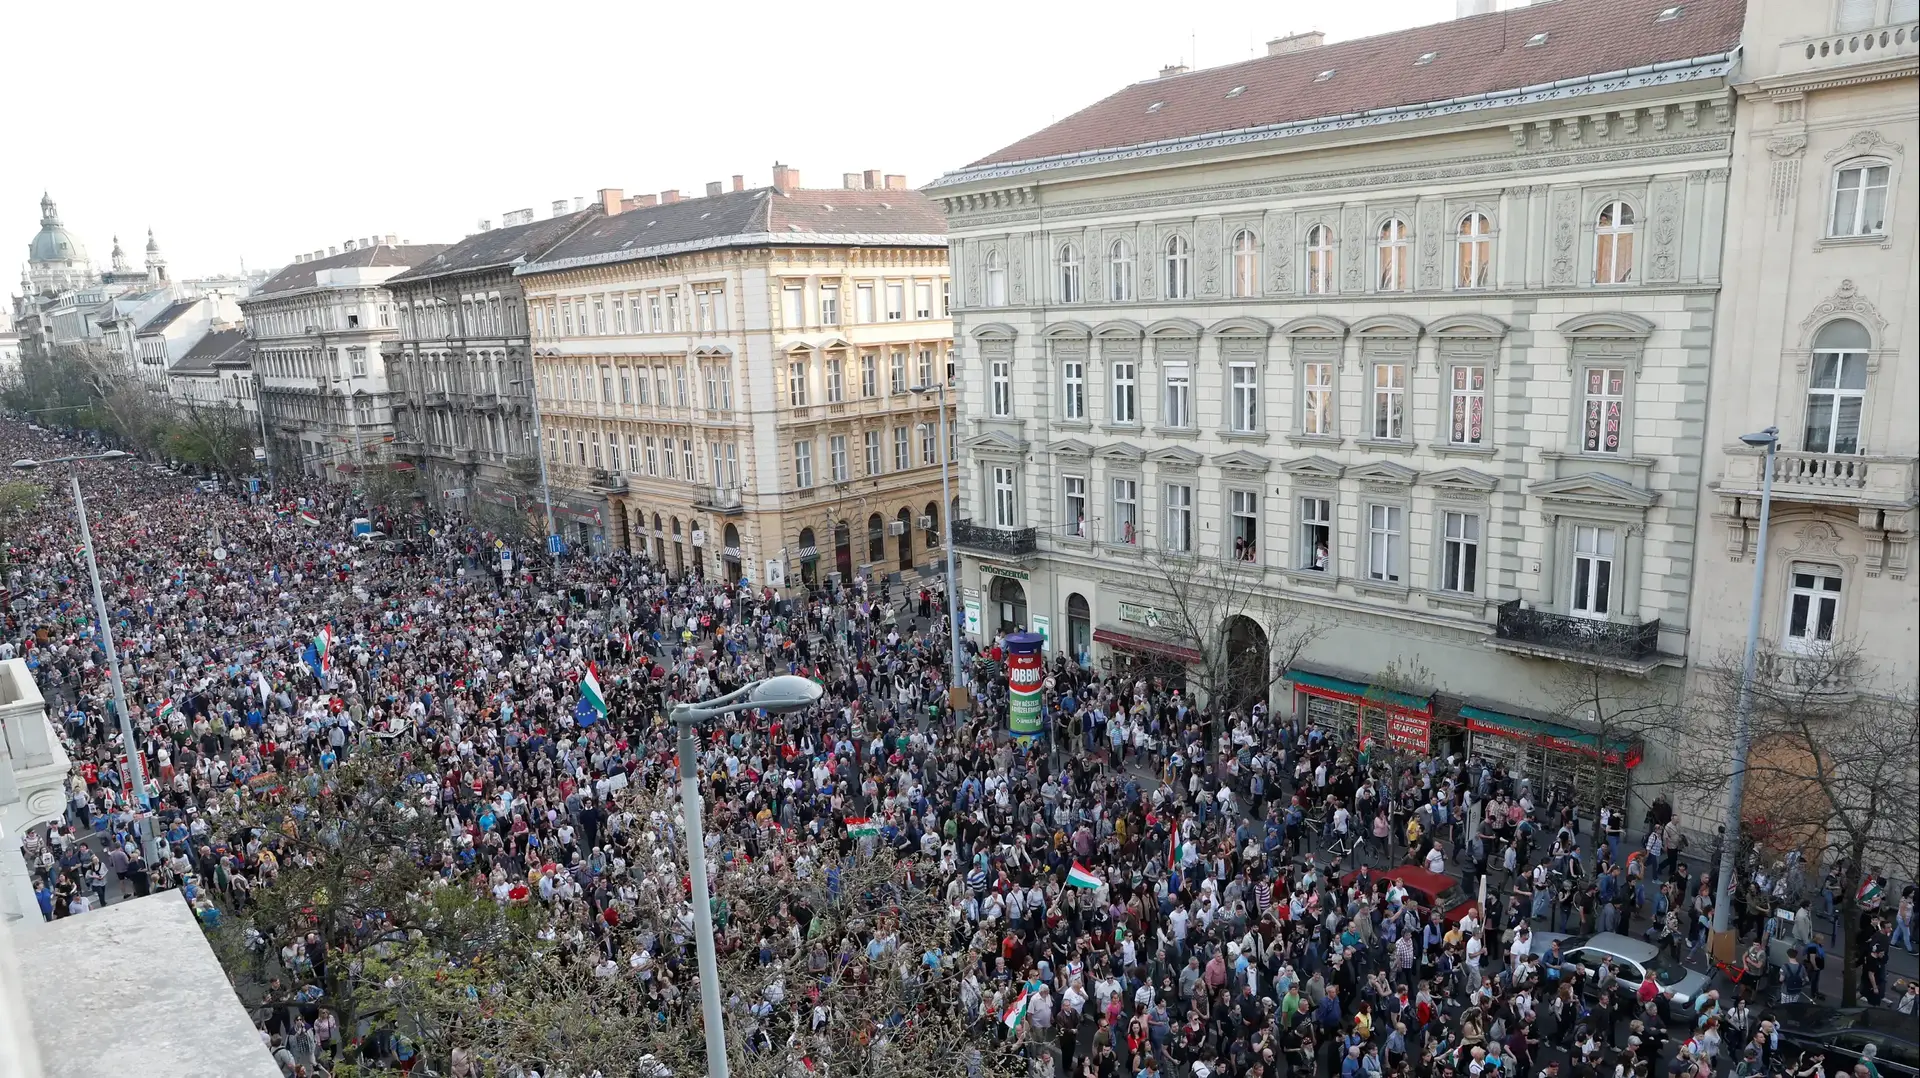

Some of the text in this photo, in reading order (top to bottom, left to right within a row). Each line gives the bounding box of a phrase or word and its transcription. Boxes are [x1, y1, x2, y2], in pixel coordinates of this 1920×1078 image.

[1471, 375, 1483, 439] TÁNC
[1607, 379, 1621, 448] TÁNC
[1011, 667, 1040, 683] JOBBIK
